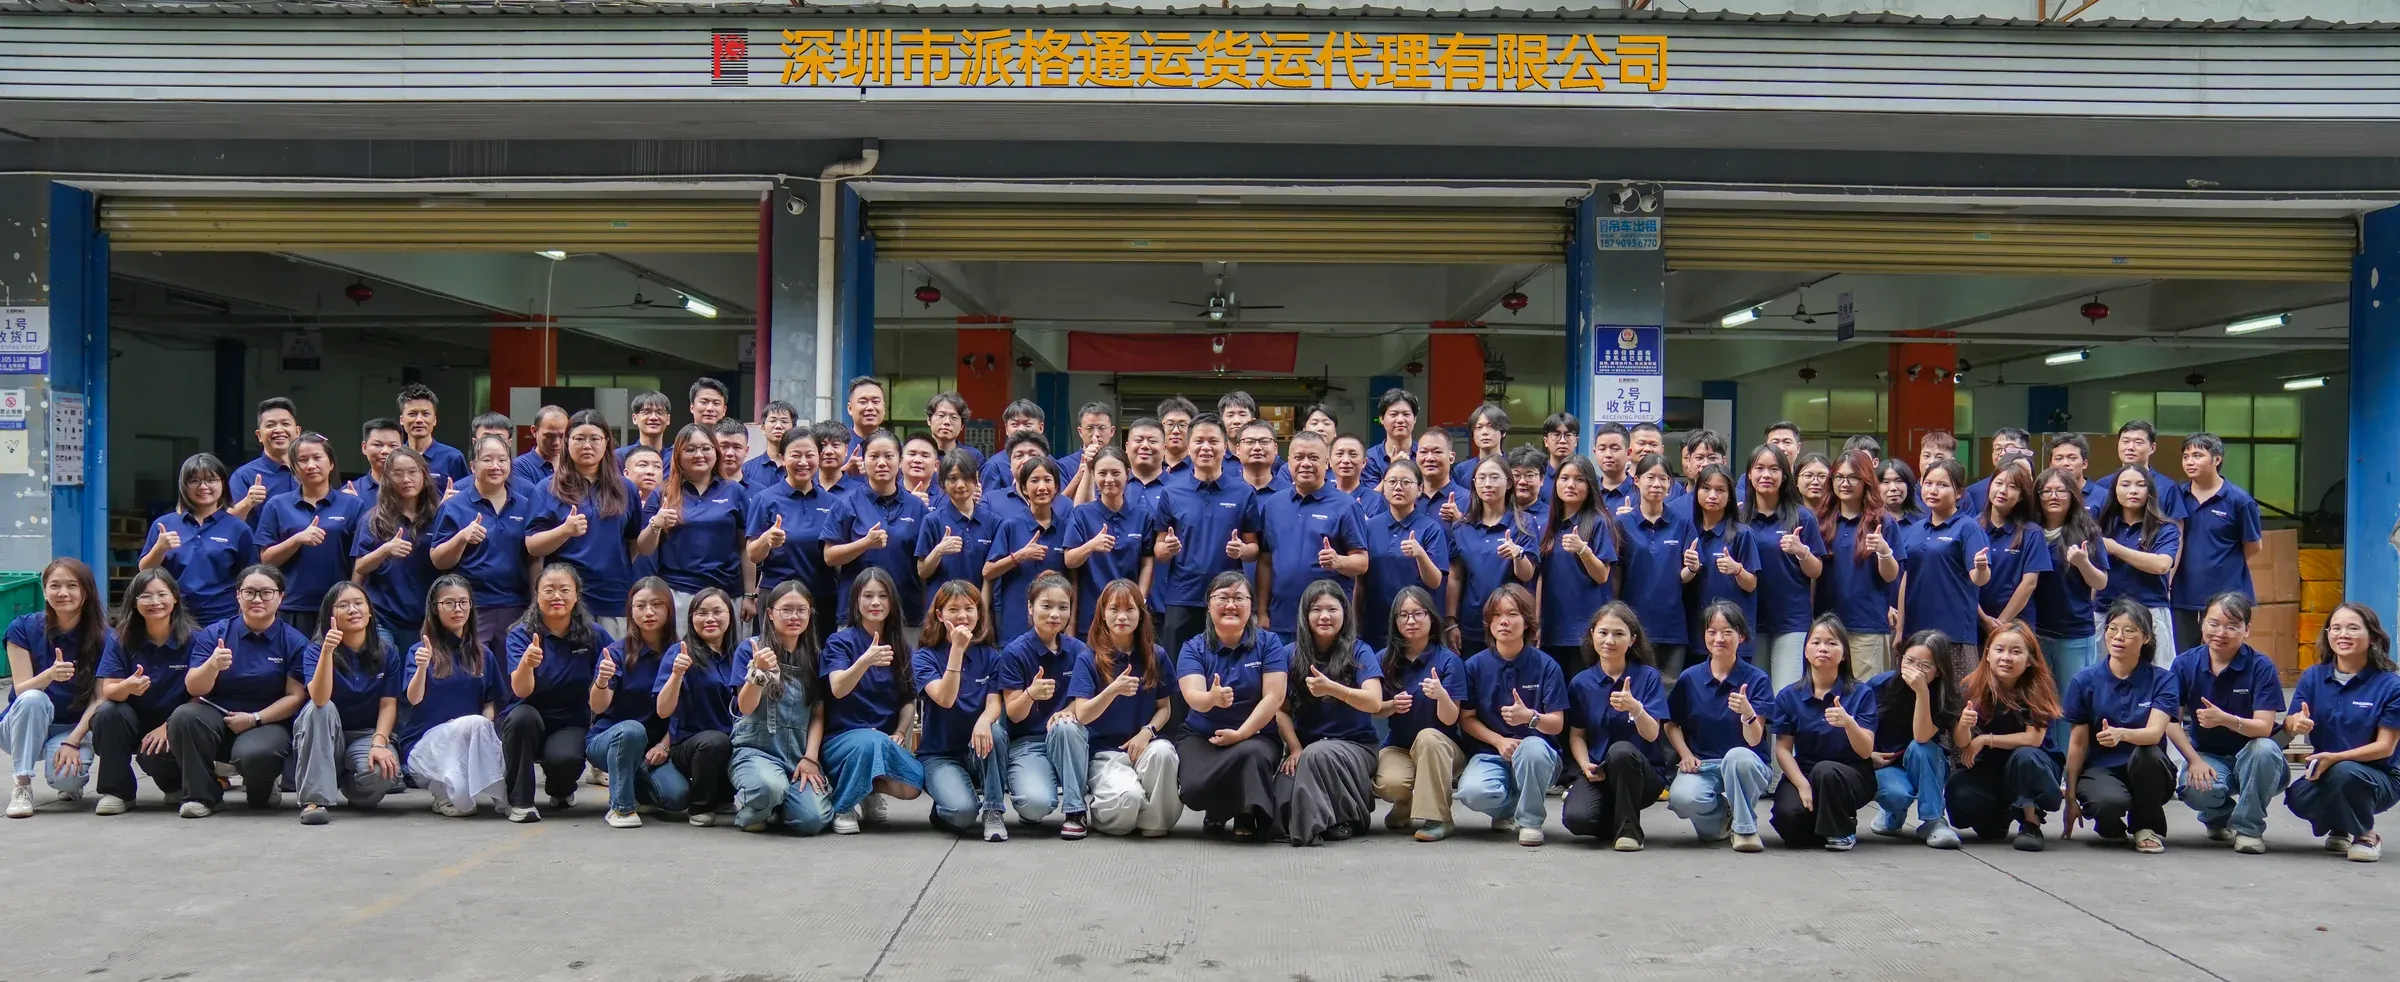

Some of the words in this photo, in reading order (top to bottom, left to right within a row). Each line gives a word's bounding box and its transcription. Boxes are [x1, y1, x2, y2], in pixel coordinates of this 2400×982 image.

[781, 28, 1668, 90] 深圳市派格通运货运代理有限公司
[1608, 220, 1657, 232] 吊车出租
[1617, 387, 1640, 400] 2号
[1606, 400, 1651, 413] 收货口
